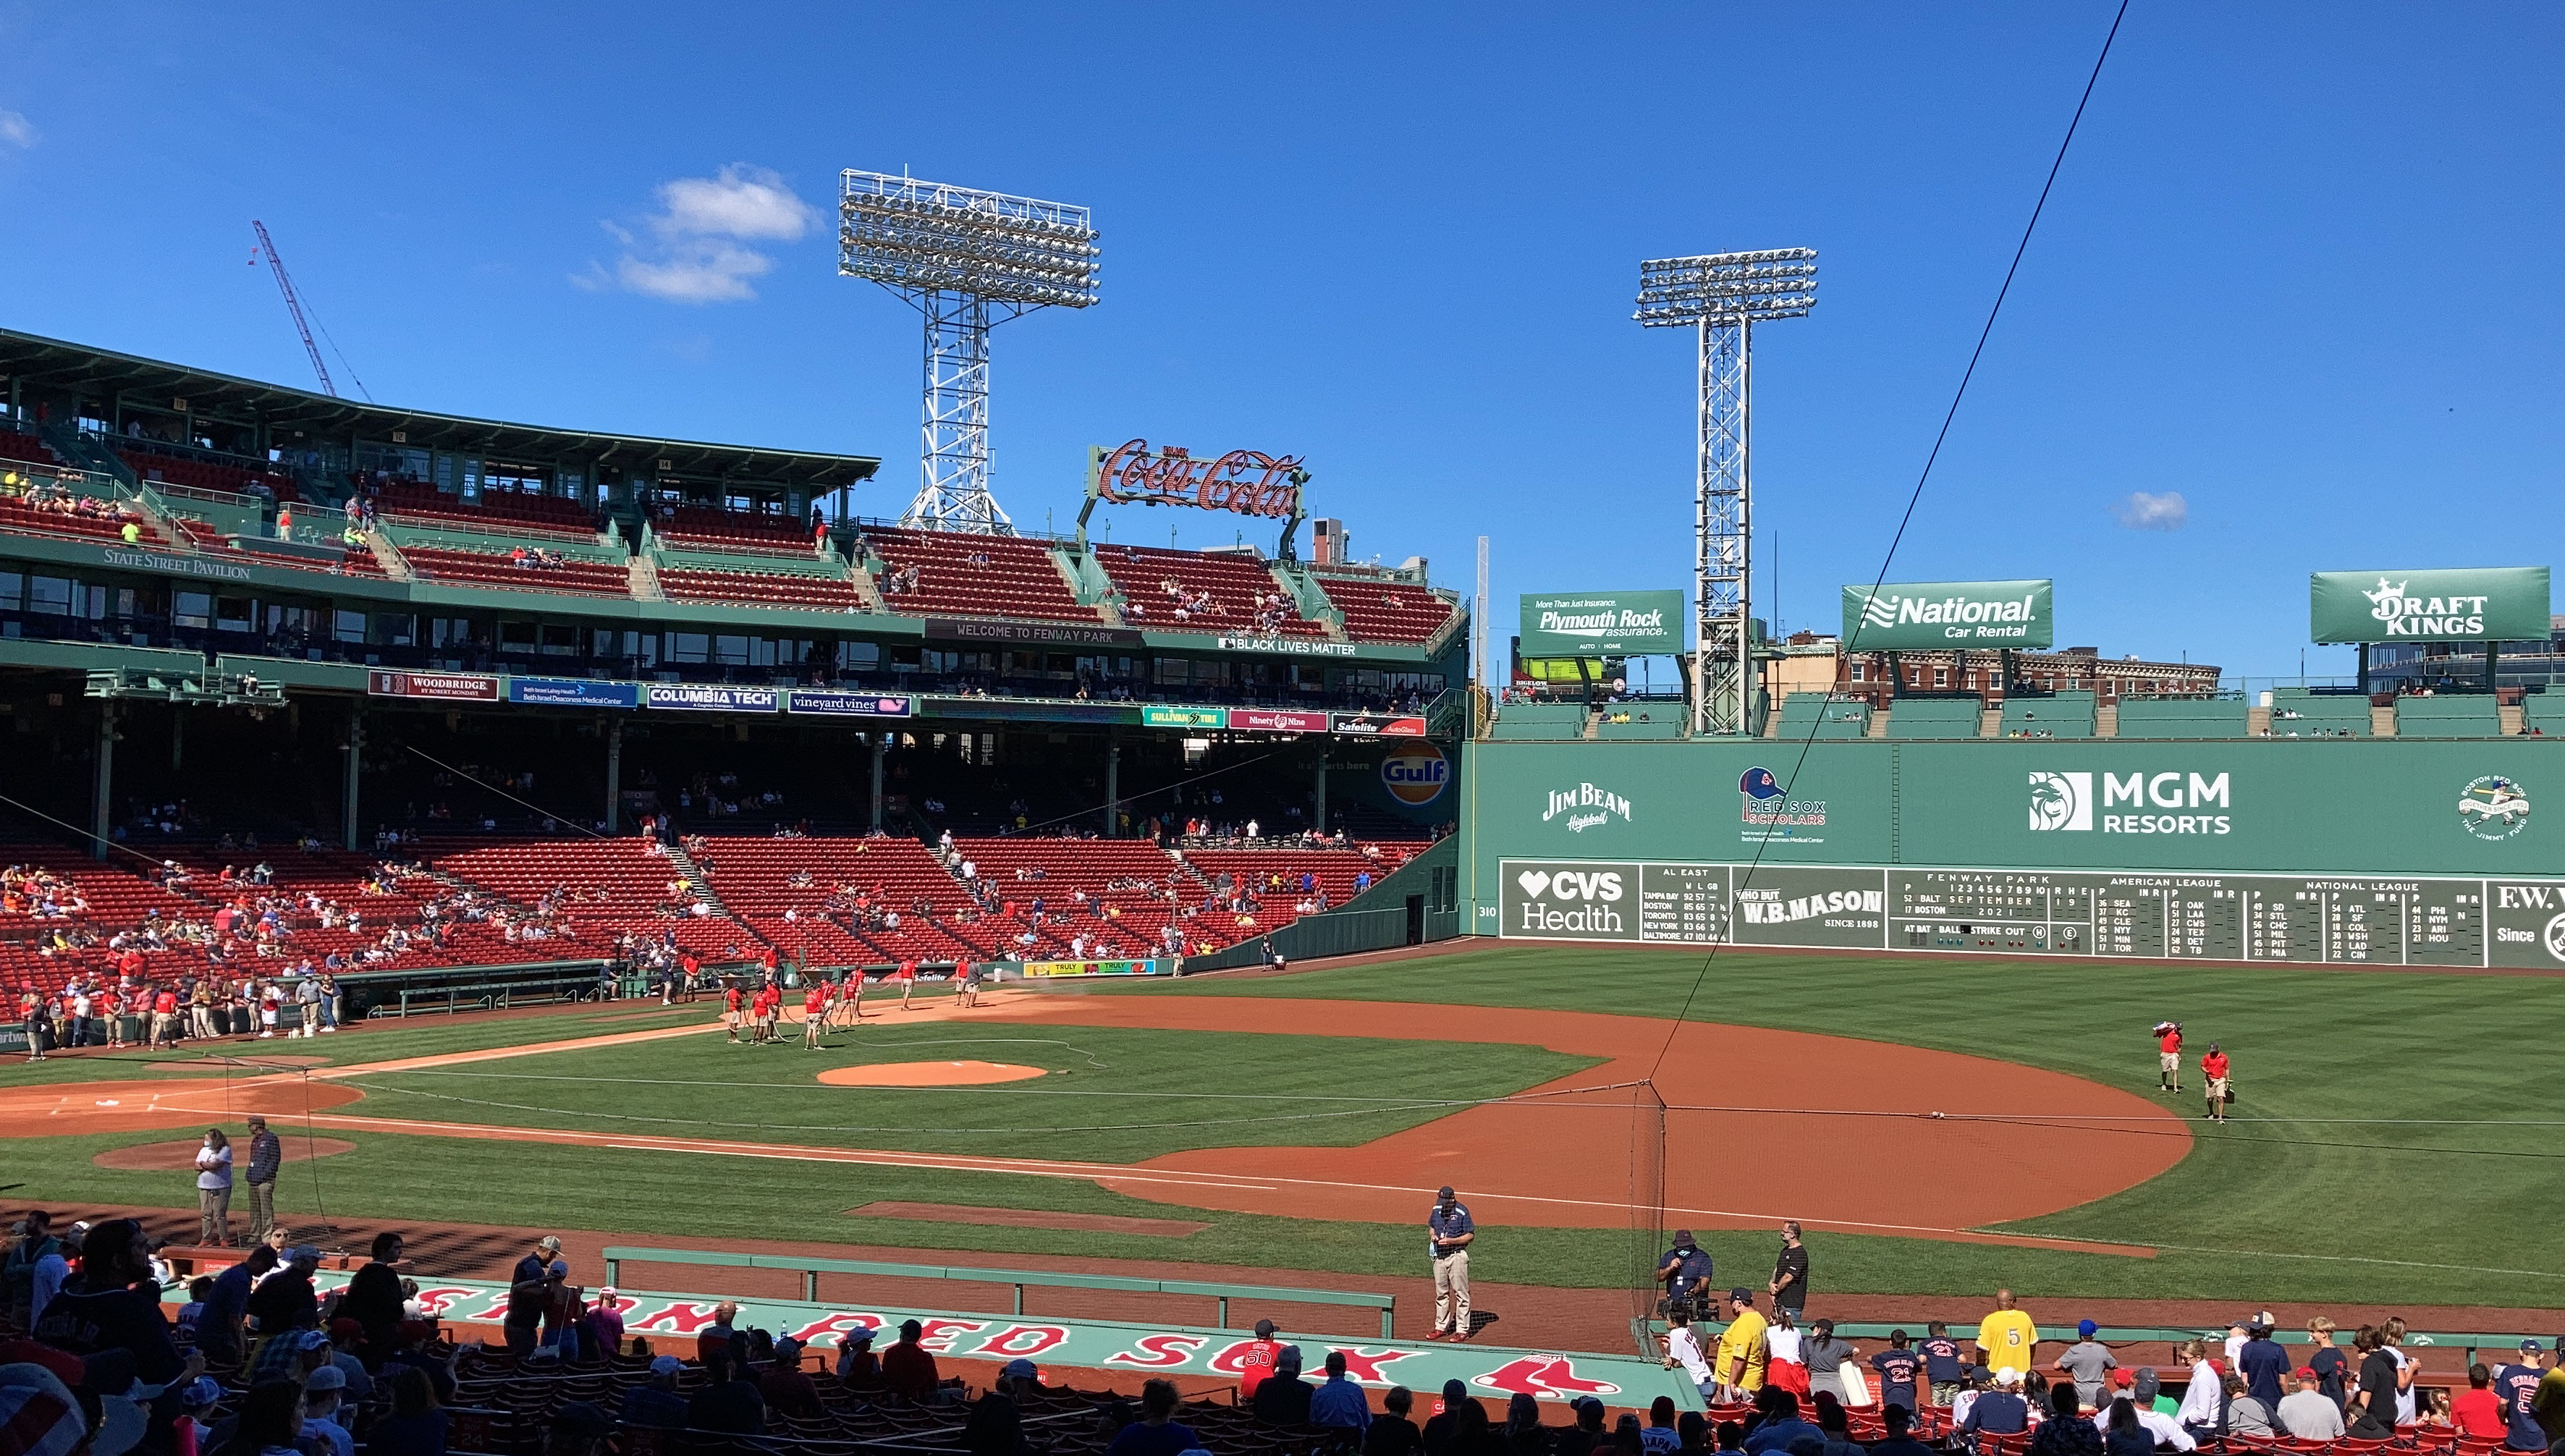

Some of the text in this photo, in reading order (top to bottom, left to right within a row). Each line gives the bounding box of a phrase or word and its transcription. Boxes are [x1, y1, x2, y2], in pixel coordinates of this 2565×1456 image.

[104, 549, 250, 579] STATE STREET PAVILION
[2372, 596, 2488, 620] DRAFT
[1540, 609, 1662, 630] Plymouth Rock
[2386, 616, 2485, 635] KINGS
[957, 625, 1112, 643] WELCOME TO FENWAY PARK
[1945, 625, 2027, 638] Car Rental
[1238, 639, 1355, 655] BLACK LIVES MATTER
[651, 690, 772, 704] COLUMBIA TECH
[794, 698, 876, 710] vineyard vines
[1151, 712, 1188, 721] SULLIVAN
[1249, 716, 1273, 725] Ninety
[1338, 723, 1377, 732] Safelite
[1384, 761, 1445, 782] Gulf
[2104, 772, 2229, 808] MGM
[2462, 776, 2490, 796] BOSTON
[2513, 783, 2527, 797] SOX
[1543, 783, 1631, 822] JIM BEAM
[1750, 801, 1825, 813] RED SOX
[2461, 802, 2491, 810] TOGETHER
[1566, 810, 1607, 833] Highball
[1749, 814, 1825, 825] SCHOLARS
[2104, 816, 2231, 834] RESORTS
[2462, 818, 2475, 833] THE
[2509, 818, 2527, 837] FUND
[1552, 871, 1623, 901] CVS
[1927, 874, 1993, 883] FENWAY
[1761, 891, 1780, 900] BUT
[1479, 907, 1496, 917] 310
[1521, 902, 1623, 932] Health
[2498, 928, 2535, 941] Since
[792, 1311, 1071, 1359] RED
[2008, 1328, 2021, 1347] 5
[1246, 1350, 1272, 1366] 50
[1933, 1345, 1953, 1356] 21
[1891, 1368, 1911, 1382] 21
